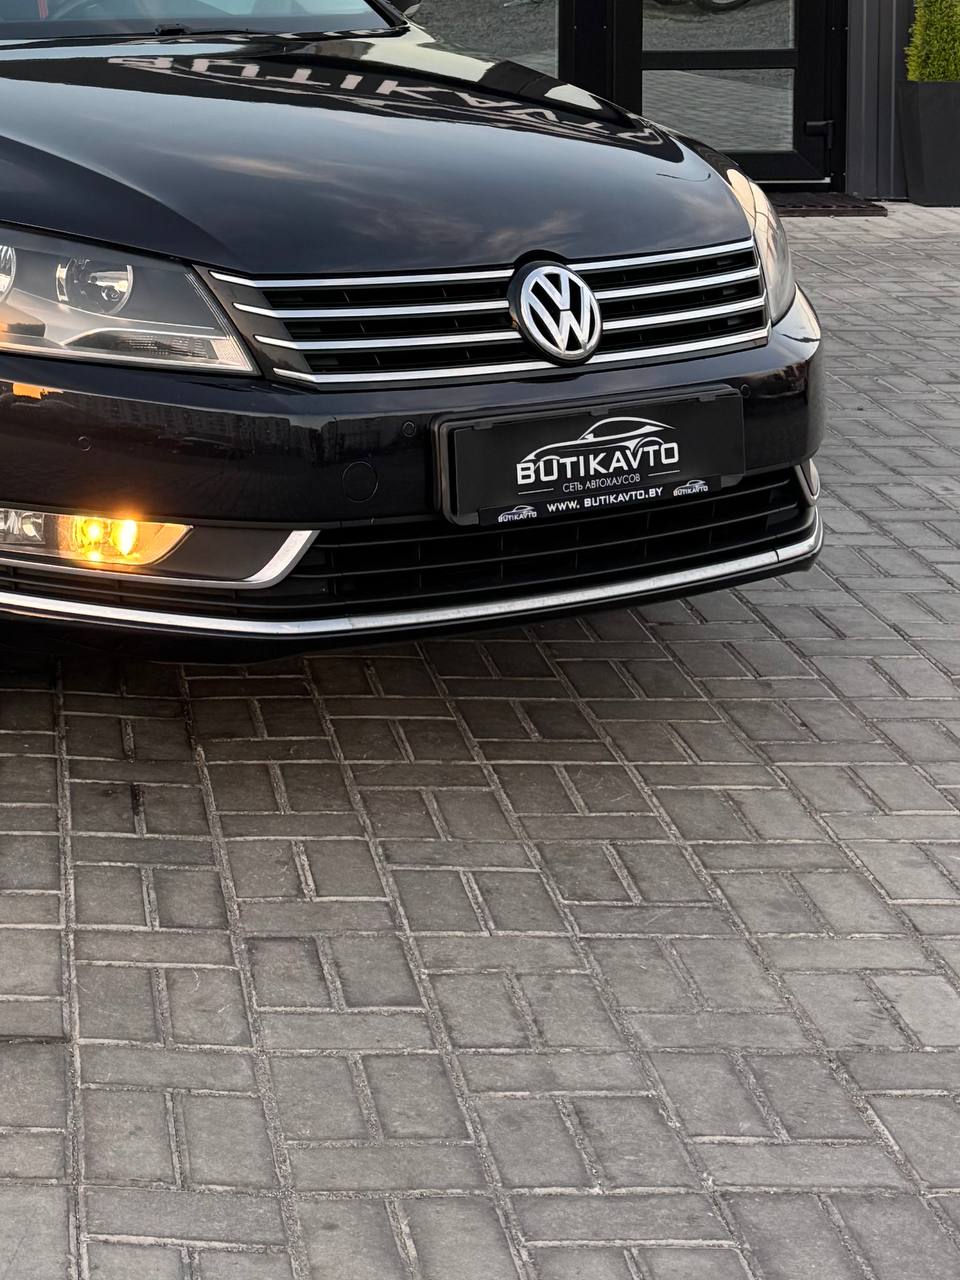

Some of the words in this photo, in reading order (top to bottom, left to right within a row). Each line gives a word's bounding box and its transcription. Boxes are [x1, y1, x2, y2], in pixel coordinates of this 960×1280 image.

[516, 442, 679, 485] BUTIKAVTO
[562, 480, 583, 492] СЕТЬ
[585, 473, 641, 491] АВТОХАУСОВ
[546, 499, 580, 512] WWW.
[584, 486, 664, 508] BUTIKAVTO.BY
[498, 508, 538, 522] BUTIKAVTO
